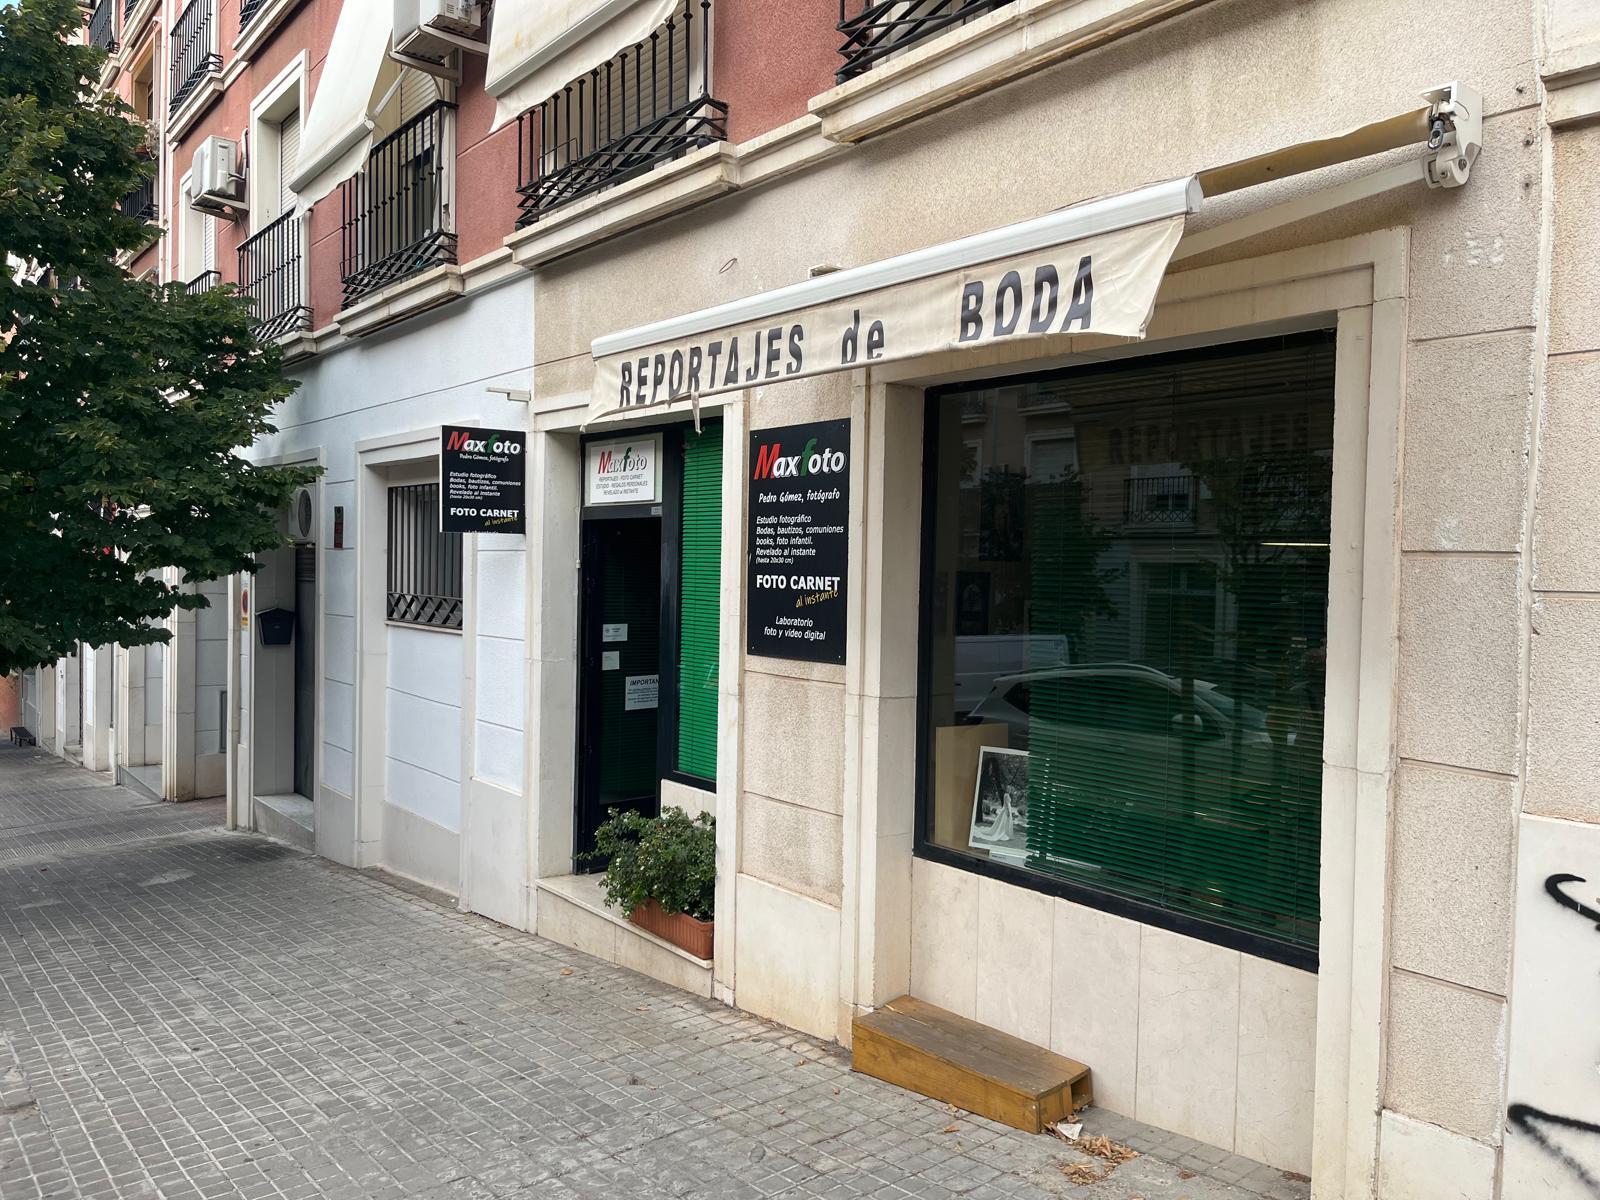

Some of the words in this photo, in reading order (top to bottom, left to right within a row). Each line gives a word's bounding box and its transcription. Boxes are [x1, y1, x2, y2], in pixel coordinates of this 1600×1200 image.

[619, 324, 804, 408] REPORTAJES
[841, 309, 885, 364] de
[959, 255, 1094, 342] BODA
[447, 431, 521, 454] Maxfoto
[598, 447, 647, 474] Maxfoto
[753, 438, 847, 480] Maxfoto
[758, 491, 777, 503] Pedro
[780, 491, 804, 503] Gómez,
[807, 487, 840, 503] fotógrafo
[450, 507, 477, 517] FOTO
[479, 508, 520, 519] CARNET
[756, 515, 778, 524] Estudio
[779, 514, 812, 525] fotográfico
[484, 519, 491, 527] al
[756, 526, 775, 535] Bodas,
[777, 526, 804, 535] bautizos,
[805, 525, 844, 534] comuniones
[756, 537, 775, 546] books,
[776, 536, 789, 545] foto
[790, 536, 813, 545] infantil.
[756, 547, 782, 556] Revelado
[783, 547, 790, 556] al
[790, 547, 816, 556] instante
[755, 556, 770, 564] (hasta
[756, 575, 787, 589] FOTO
[790, 575, 841, 591] CARNET
[795, 596, 803, 608] al
[804, 588, 839, 606] instante
[775, 615, 814, 628] Laboratorio
[763, 626, 777, 636] foto
[778, 629, 784, 638] y
[803, 630, 826, 641] digital
